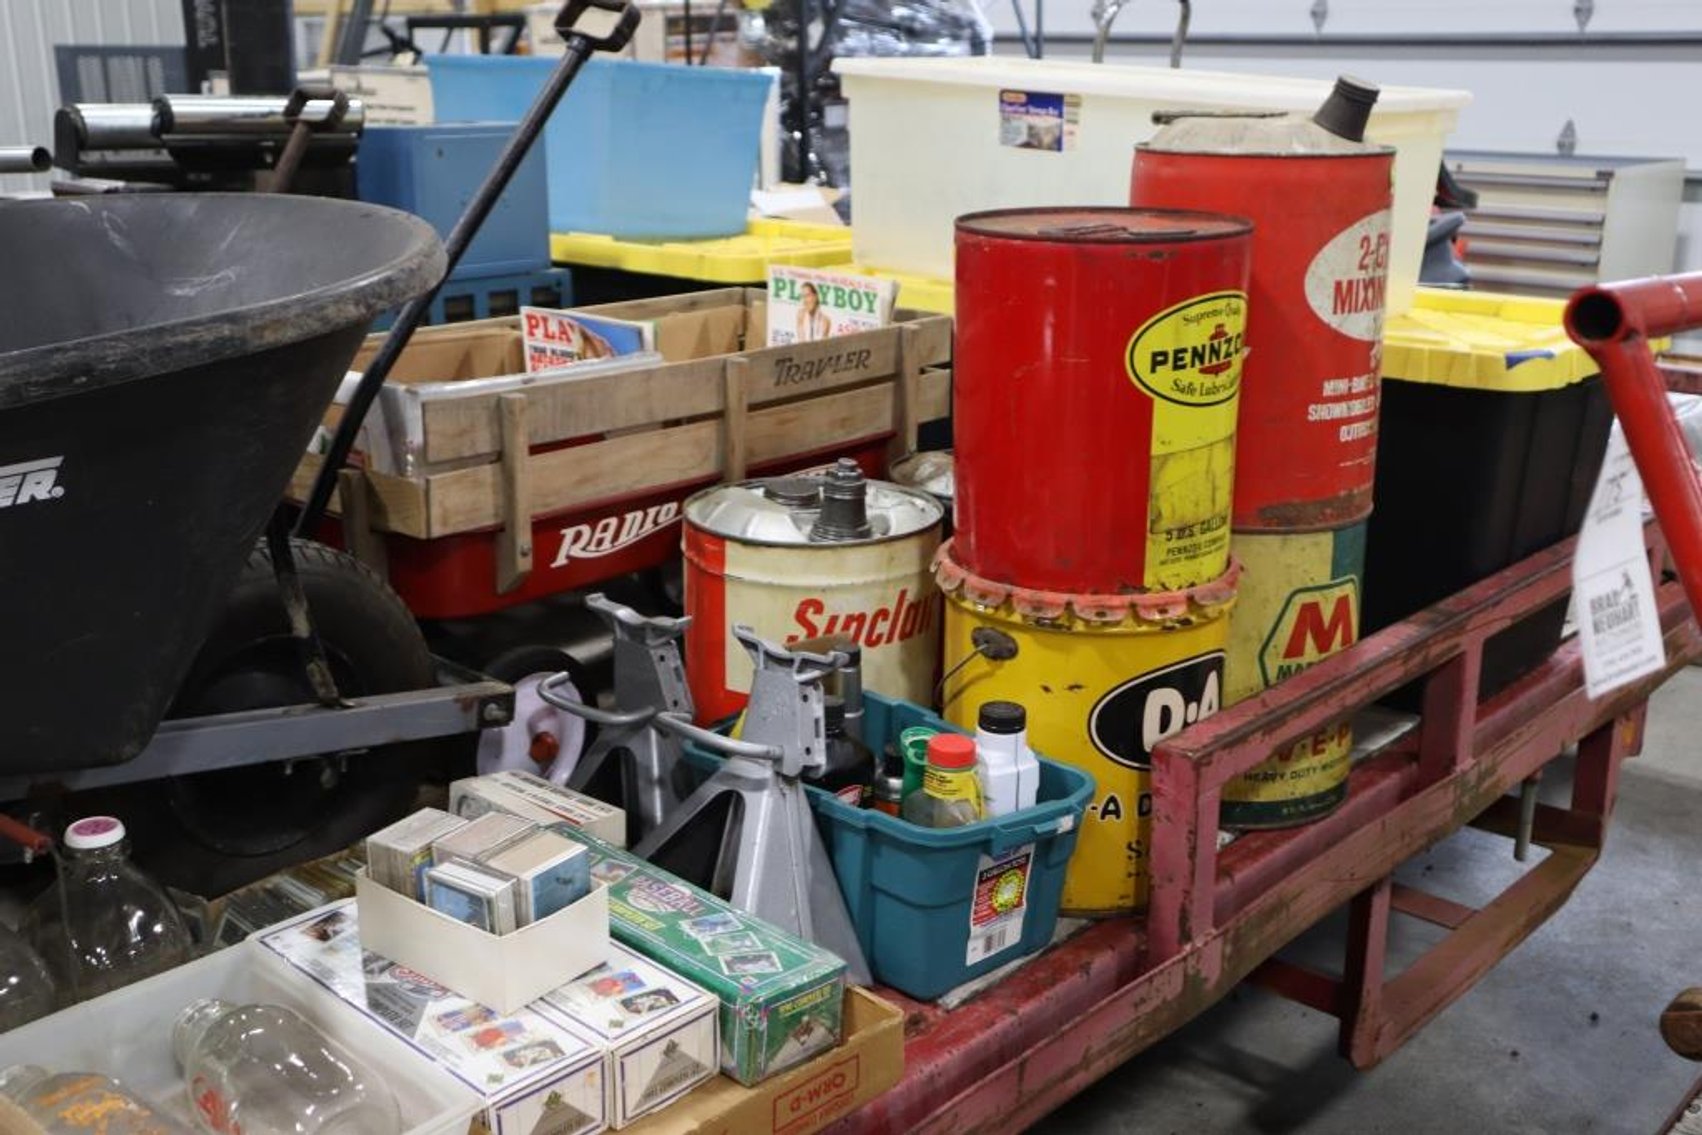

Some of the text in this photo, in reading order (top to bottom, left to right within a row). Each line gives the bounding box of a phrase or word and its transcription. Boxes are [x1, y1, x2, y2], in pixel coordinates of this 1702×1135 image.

[771, 275, 879, 315] PLYBOY
[1170, 377, 1197, 397] Safe
[549, 501, 680, 569] RADIO
[1282, 594, 1355, 661] M
